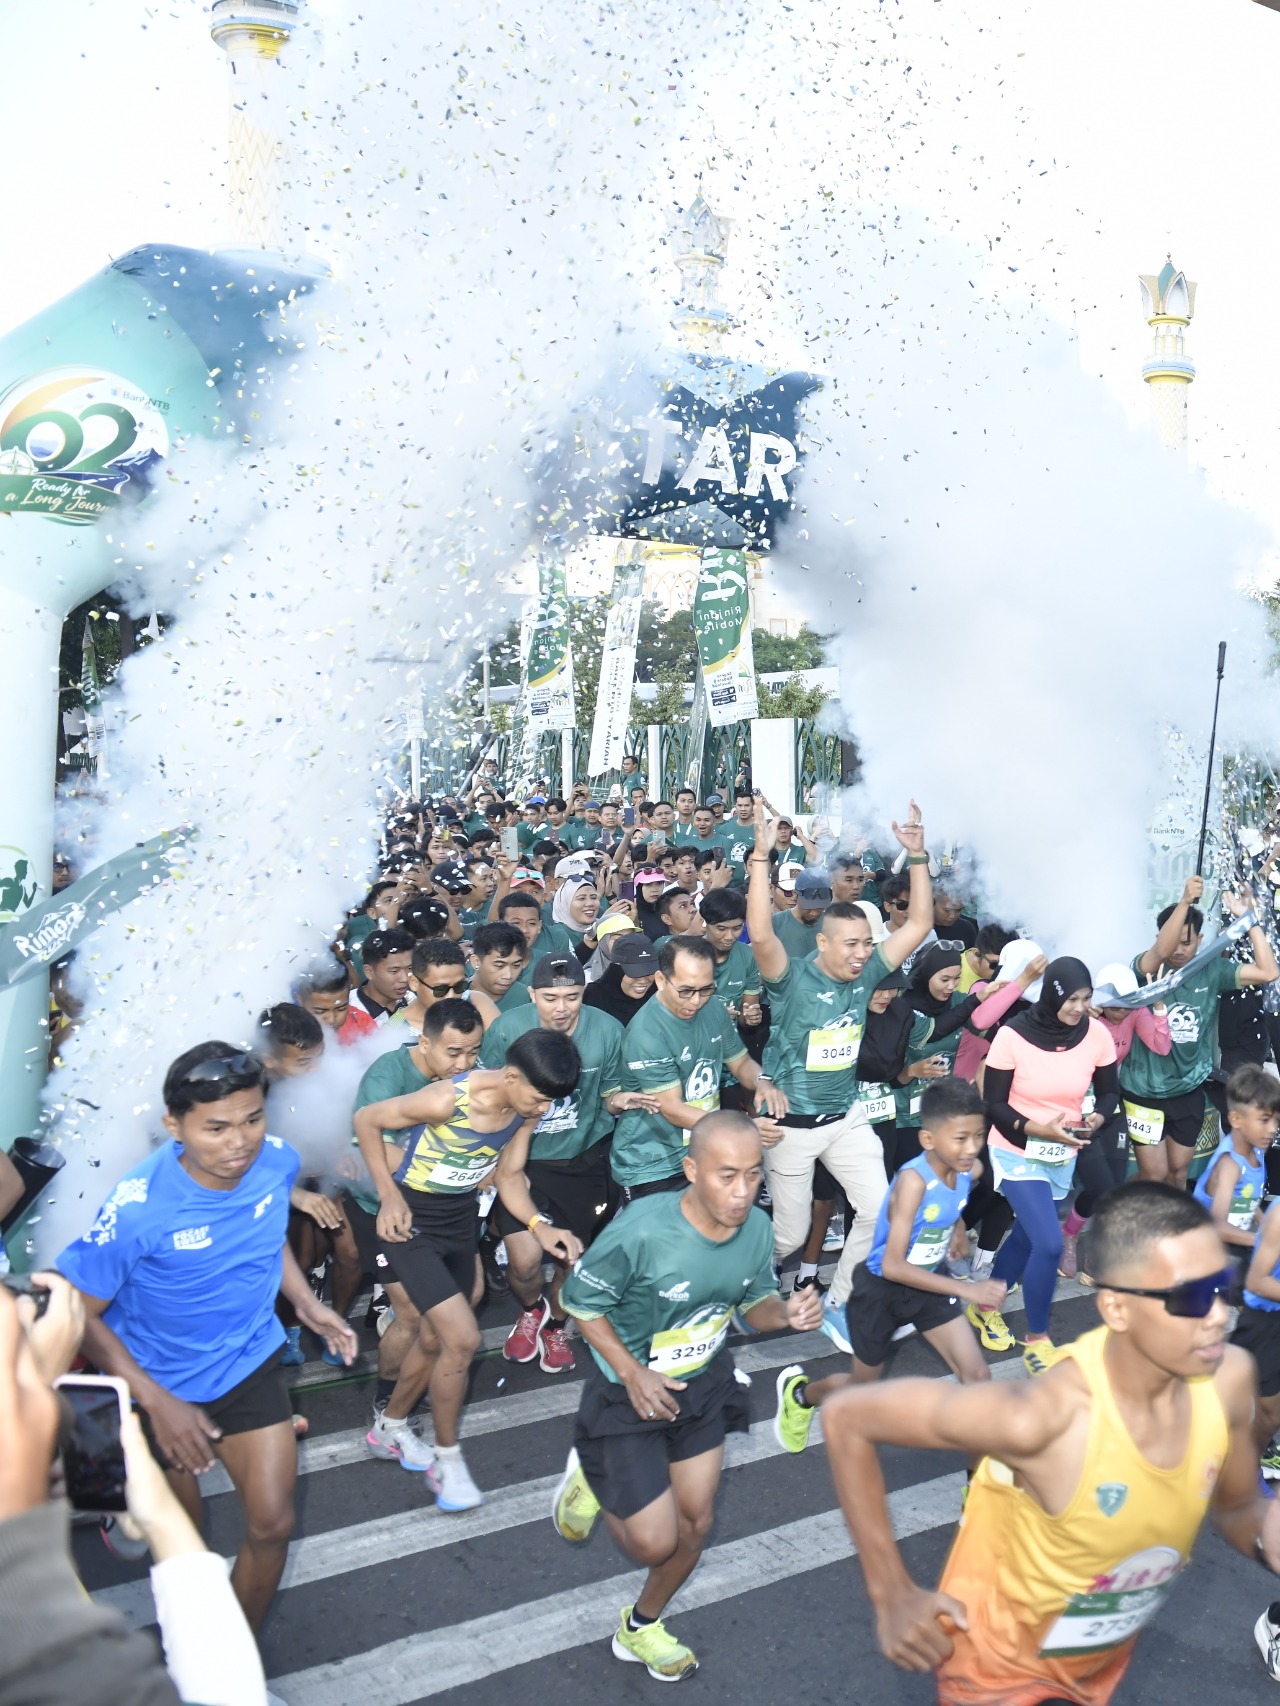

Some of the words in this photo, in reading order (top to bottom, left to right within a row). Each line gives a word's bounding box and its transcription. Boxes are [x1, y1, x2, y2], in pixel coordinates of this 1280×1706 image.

[1, 376, 139, 475] 62
[32, 478, 72, 497] Ready
[4, 492, 18, 502] a
[20, 489, 64, 512] Long
[12, 918, 68, 958] Rimo
[1167, 1005, 1196, 1031] 62
[822, 1045, 852, 1060] 3048
[865, 1100, 887, 1114] 1670
[1127, 1118, 1152, 1134] 3443
[1038, 1145, 1066, 1157] 2426
[658, 1289, 690, 1300] Berkah
